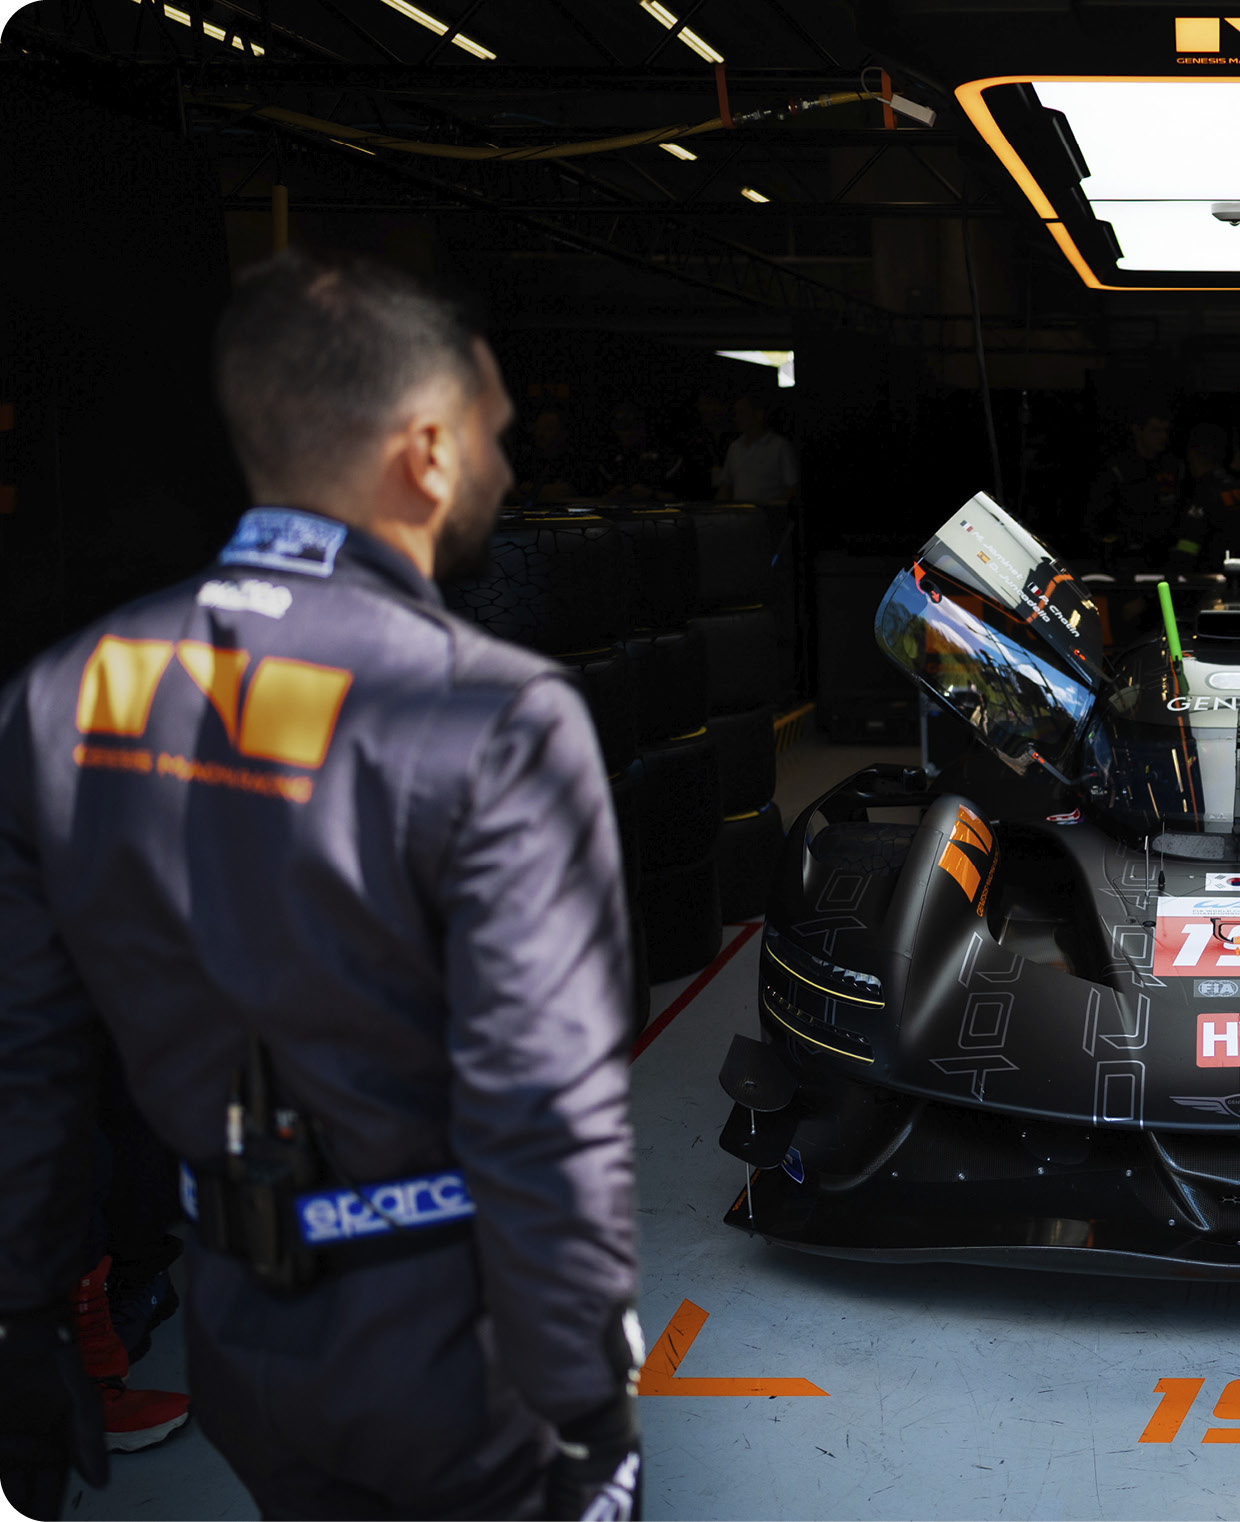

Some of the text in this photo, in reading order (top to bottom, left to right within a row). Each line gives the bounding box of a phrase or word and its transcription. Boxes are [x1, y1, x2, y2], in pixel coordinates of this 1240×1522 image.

[1176, 57, 1227, 65] GENESIS
[1049, 604, 1081, 637] Chatin
[1201, 982, 1237, 995] FIA
